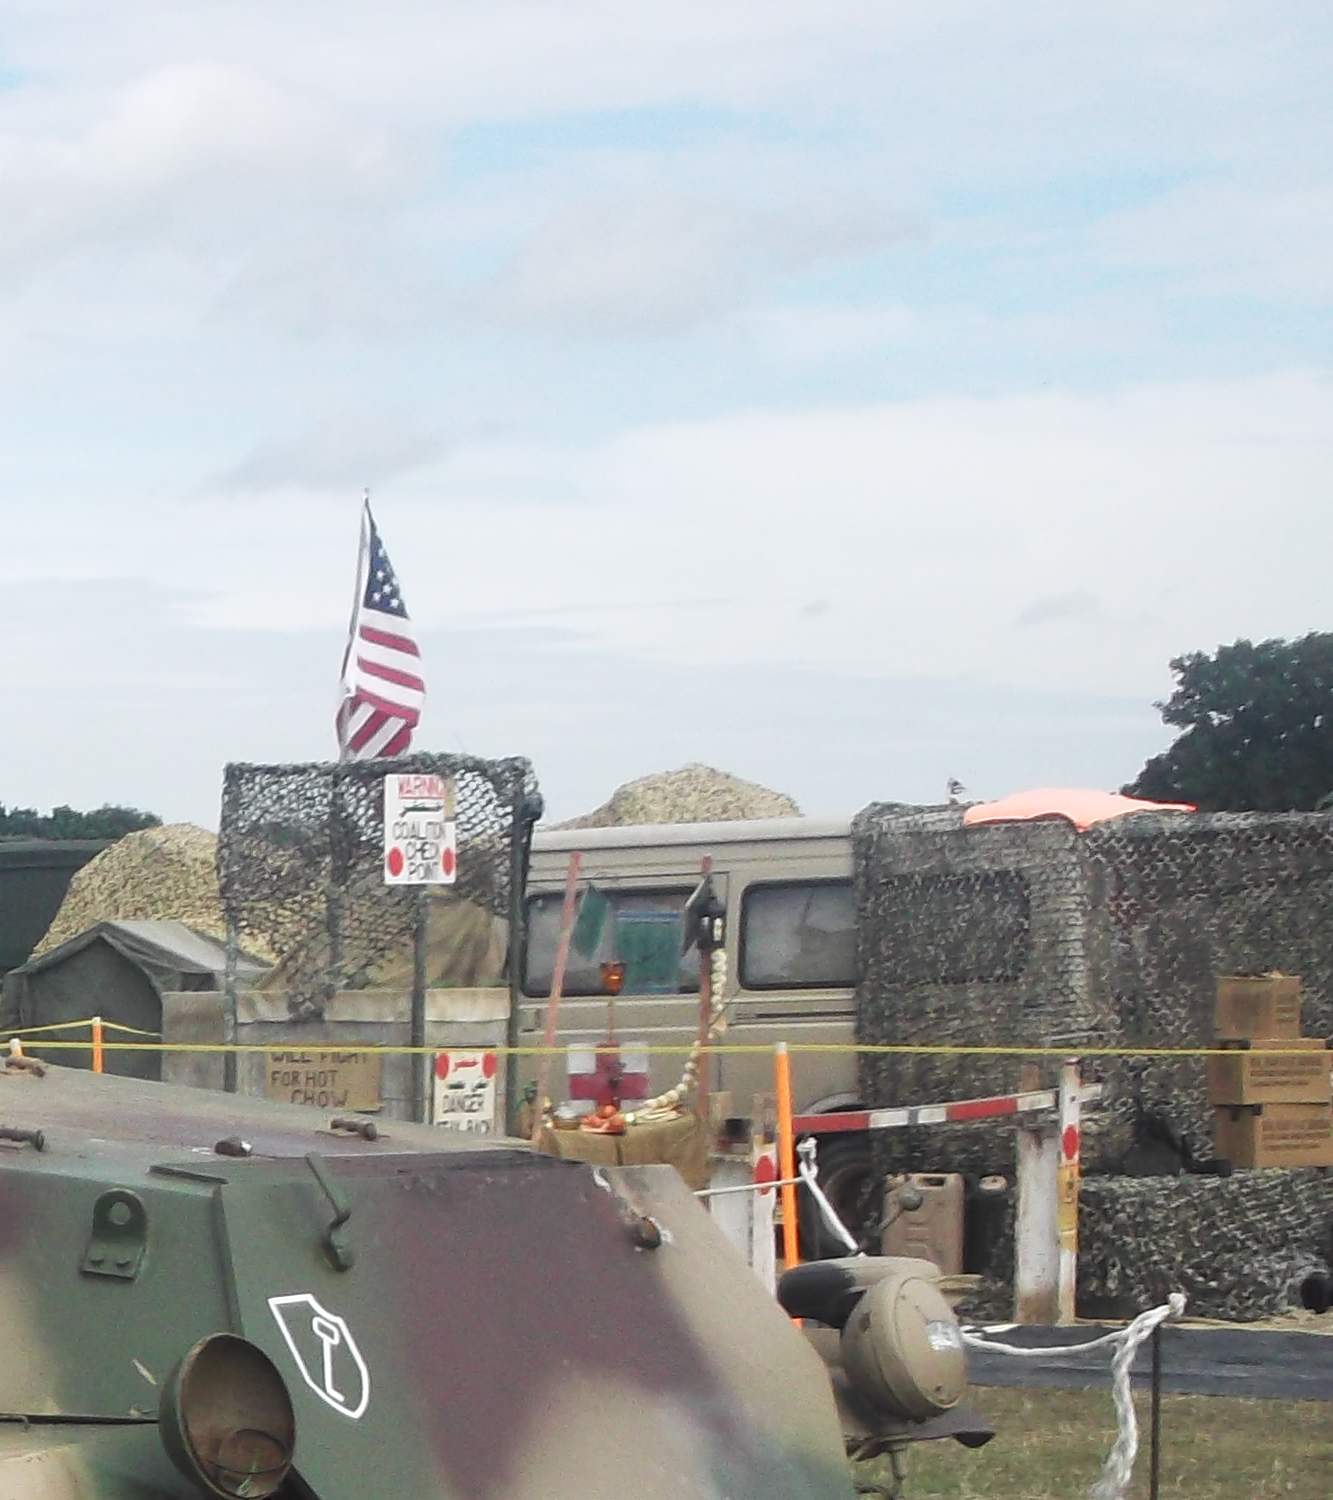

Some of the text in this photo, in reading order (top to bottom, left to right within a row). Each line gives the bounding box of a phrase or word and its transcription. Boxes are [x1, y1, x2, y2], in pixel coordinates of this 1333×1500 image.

[271, 1069, 338, 1088] FOR HOT
[291, 1088, 349, 1108] CHOW
